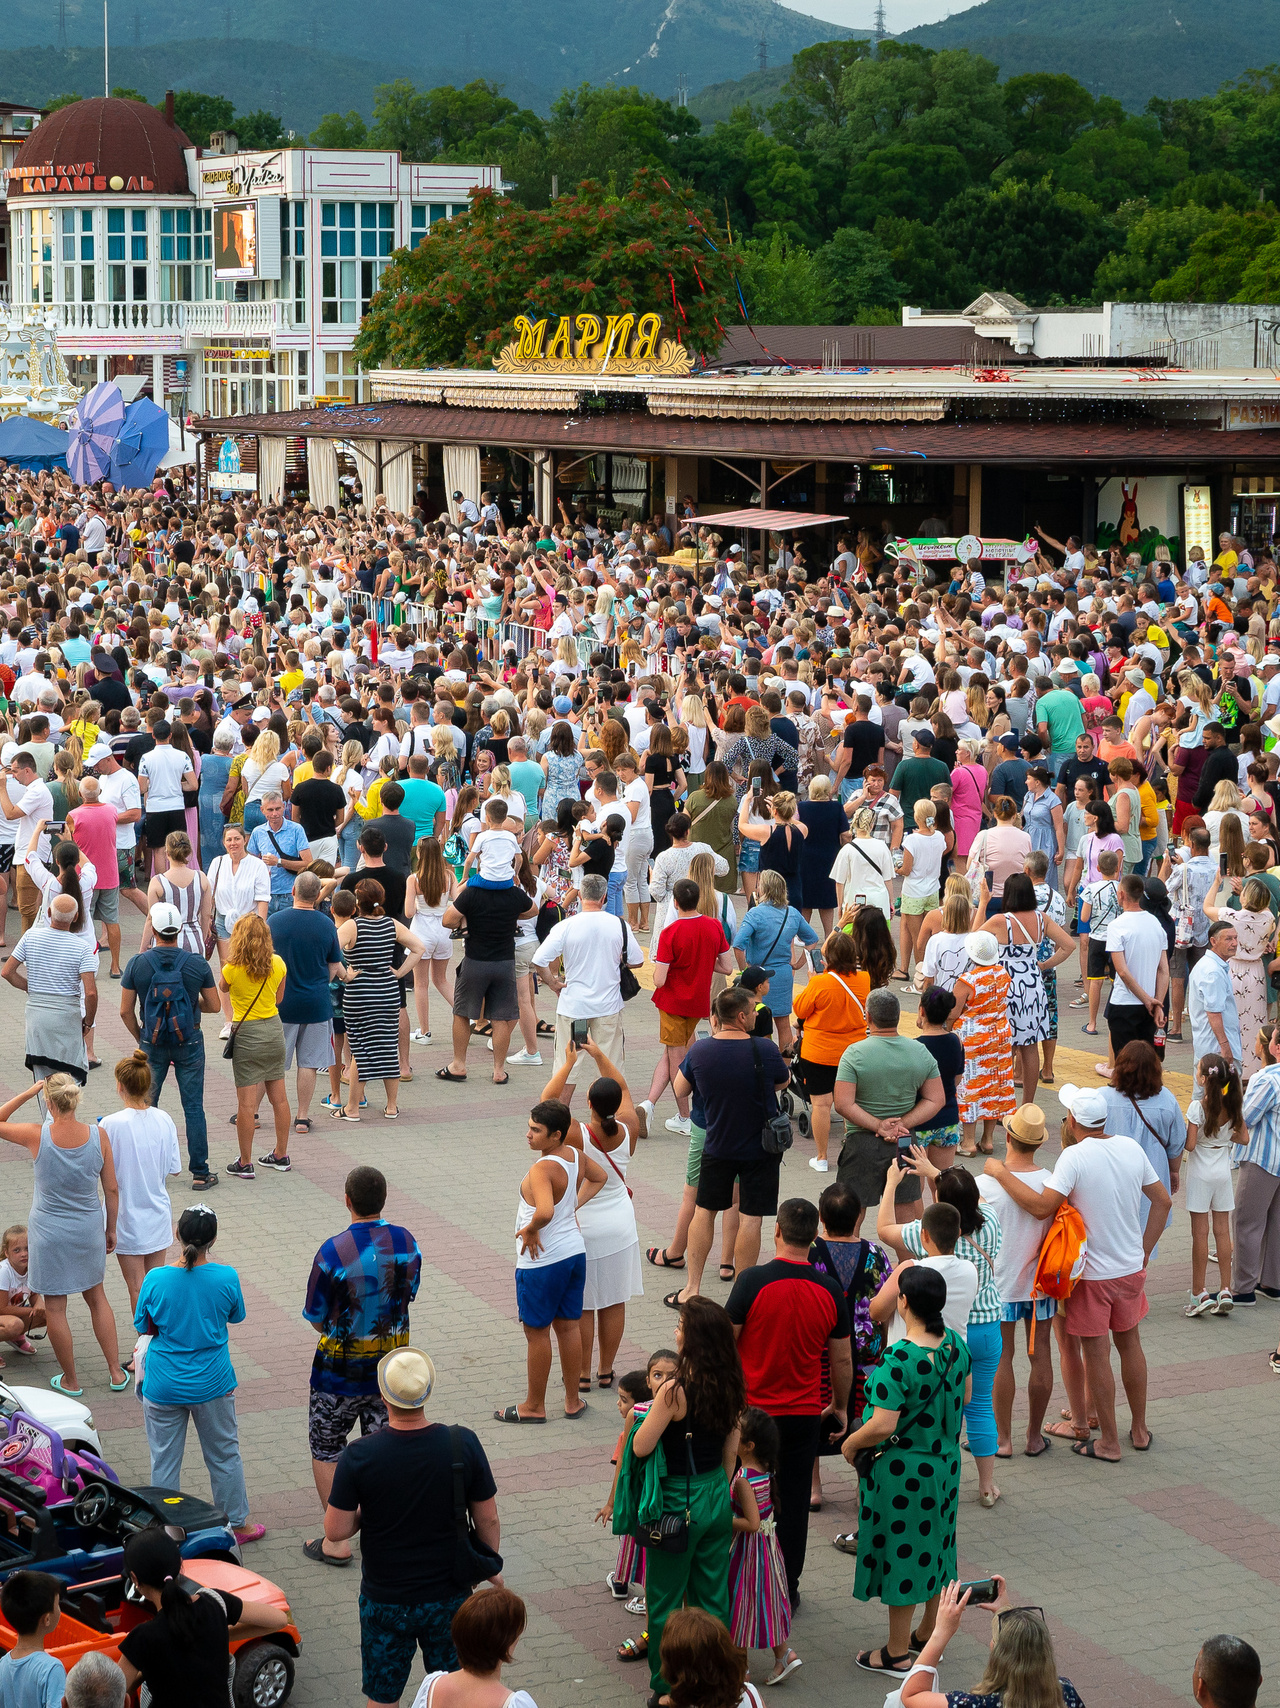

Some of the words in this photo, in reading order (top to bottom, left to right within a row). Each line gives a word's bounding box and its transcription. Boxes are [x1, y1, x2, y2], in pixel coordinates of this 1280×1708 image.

[56, 161, 95, 177] КЛУБ
[202, 169, 234, 185] караоке
[225, 182, 242, 196] бар
[513, 312, 663, 360] МАРИЯ
[221, 459, 239, 472] BAR
